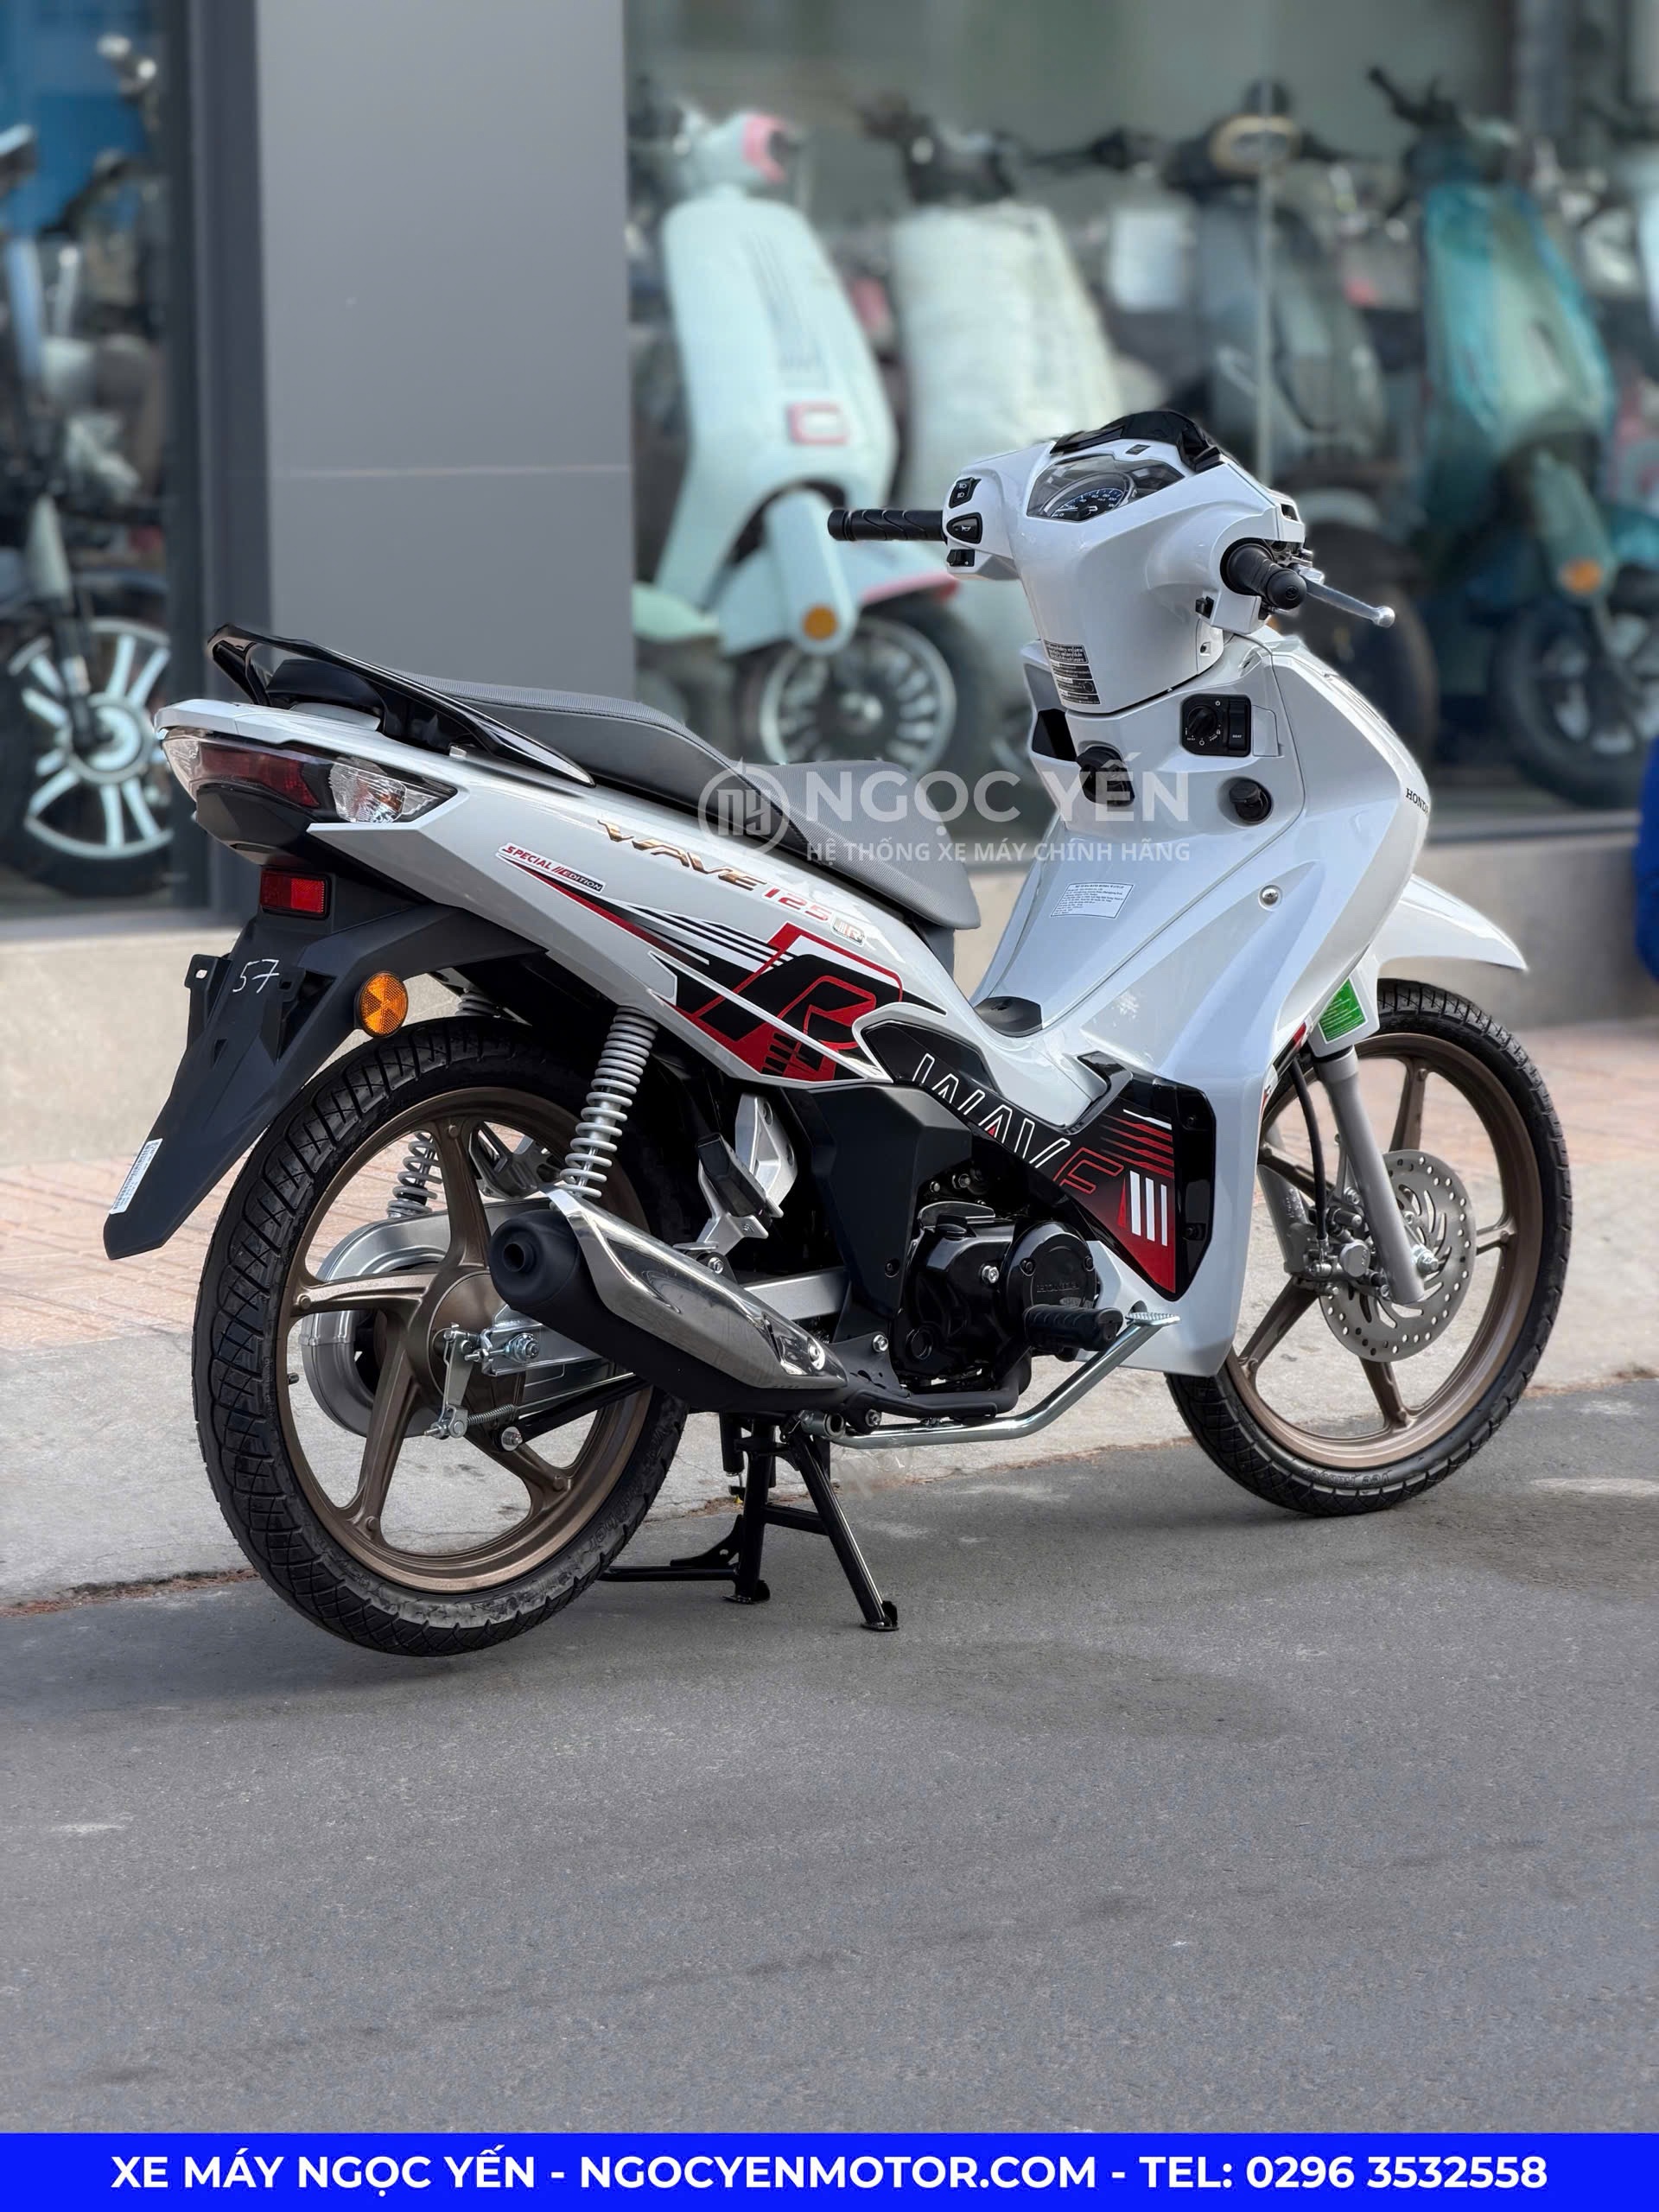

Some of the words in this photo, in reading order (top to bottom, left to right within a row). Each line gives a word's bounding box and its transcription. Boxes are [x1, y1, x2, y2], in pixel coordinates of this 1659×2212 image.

[501, 846, 553, 870] SPECIAL
[563, 868, 602, 892] EDITION
[597, 819, 767, 891] WAVE
[764, 887, 832, 921] 125
[232, 958, 280, 994] 57
